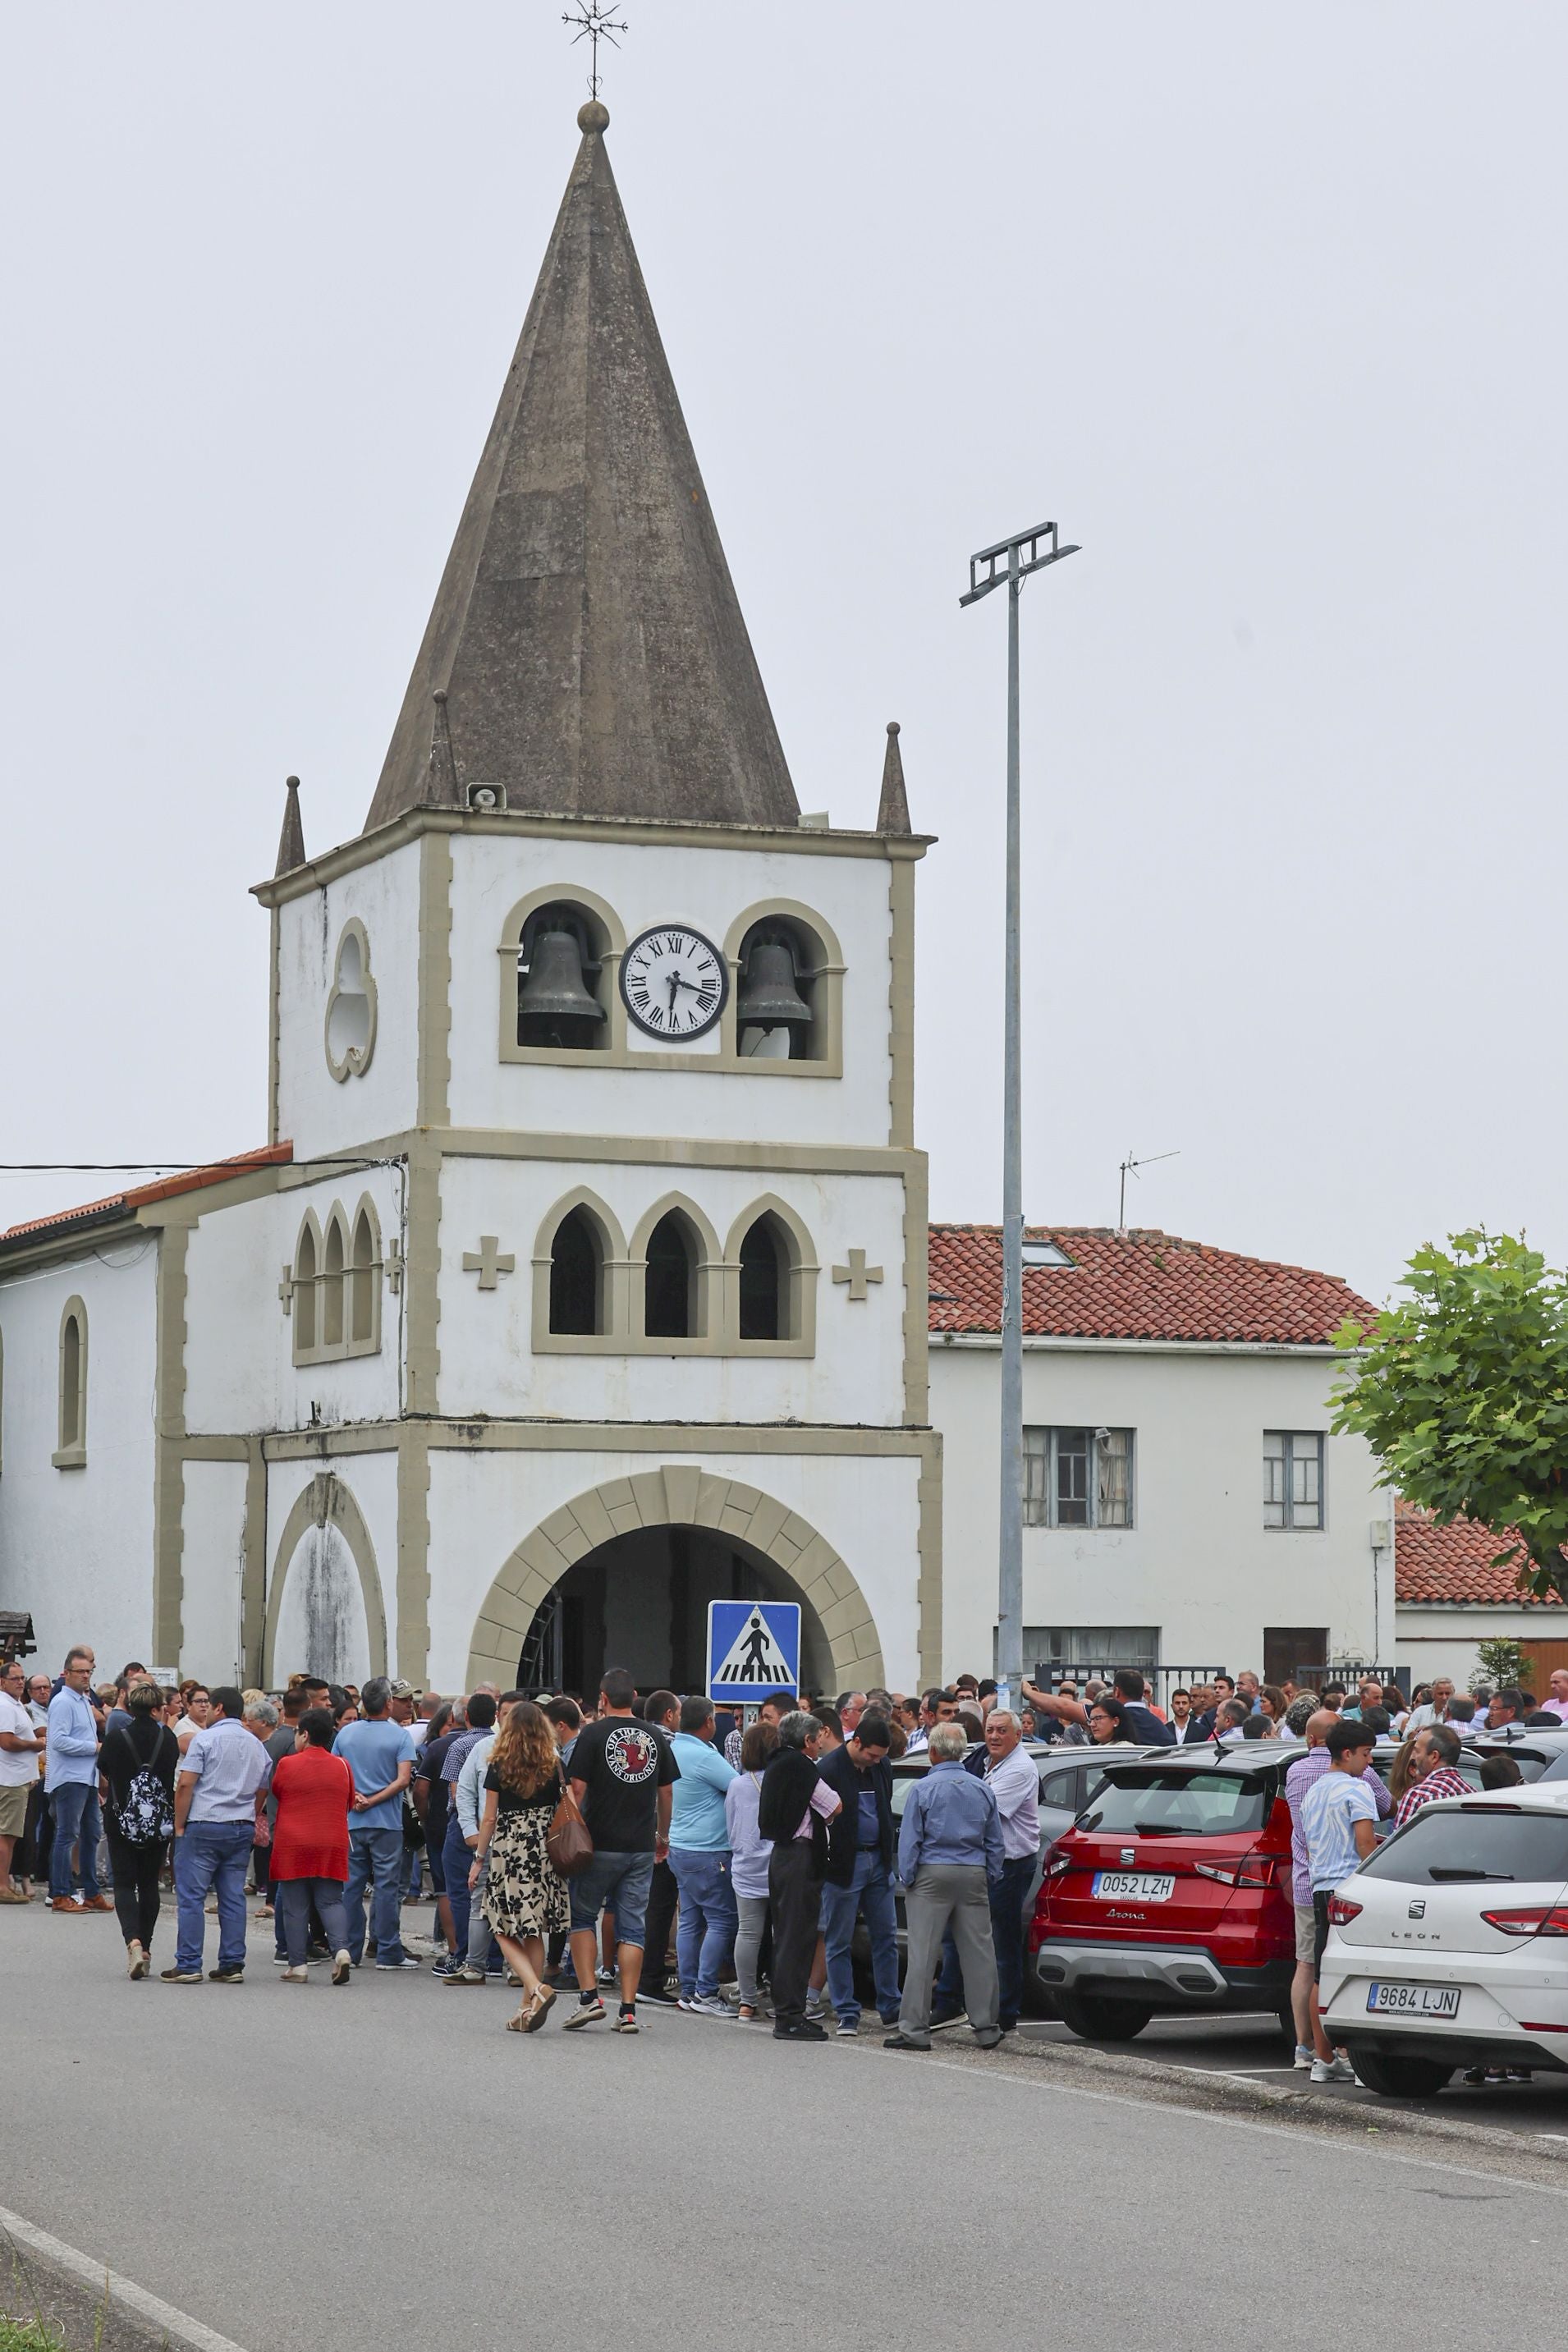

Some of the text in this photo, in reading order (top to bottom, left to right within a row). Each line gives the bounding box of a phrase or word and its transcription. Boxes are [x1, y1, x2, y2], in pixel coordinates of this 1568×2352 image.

[649, 941, 663, 959] XI
[667, 938, 682, 954] XII
[635, 955, 651, 970] X
[697, 960, 712, 971] II
[631, 974, 647, 987] IX
[702, 979, 717, 989] III
[634, 990, 652, 1011] VIII
[649, 1006, 664, 1025] VII
[688, 1010, 699, 1024] V
[607, 1729, 657, 1754] OFF THE WLL
[608, 1754, 656, 1781] VANS ORIGINAL
[1103, 1876, 1171, 1895] 0052 LZH
[1106, 1909, 1146, 1919] Arona
[1391, 1931, 1440, 1940] LEON
[1379, 1988, 1455, 2011] 9684 LJN
